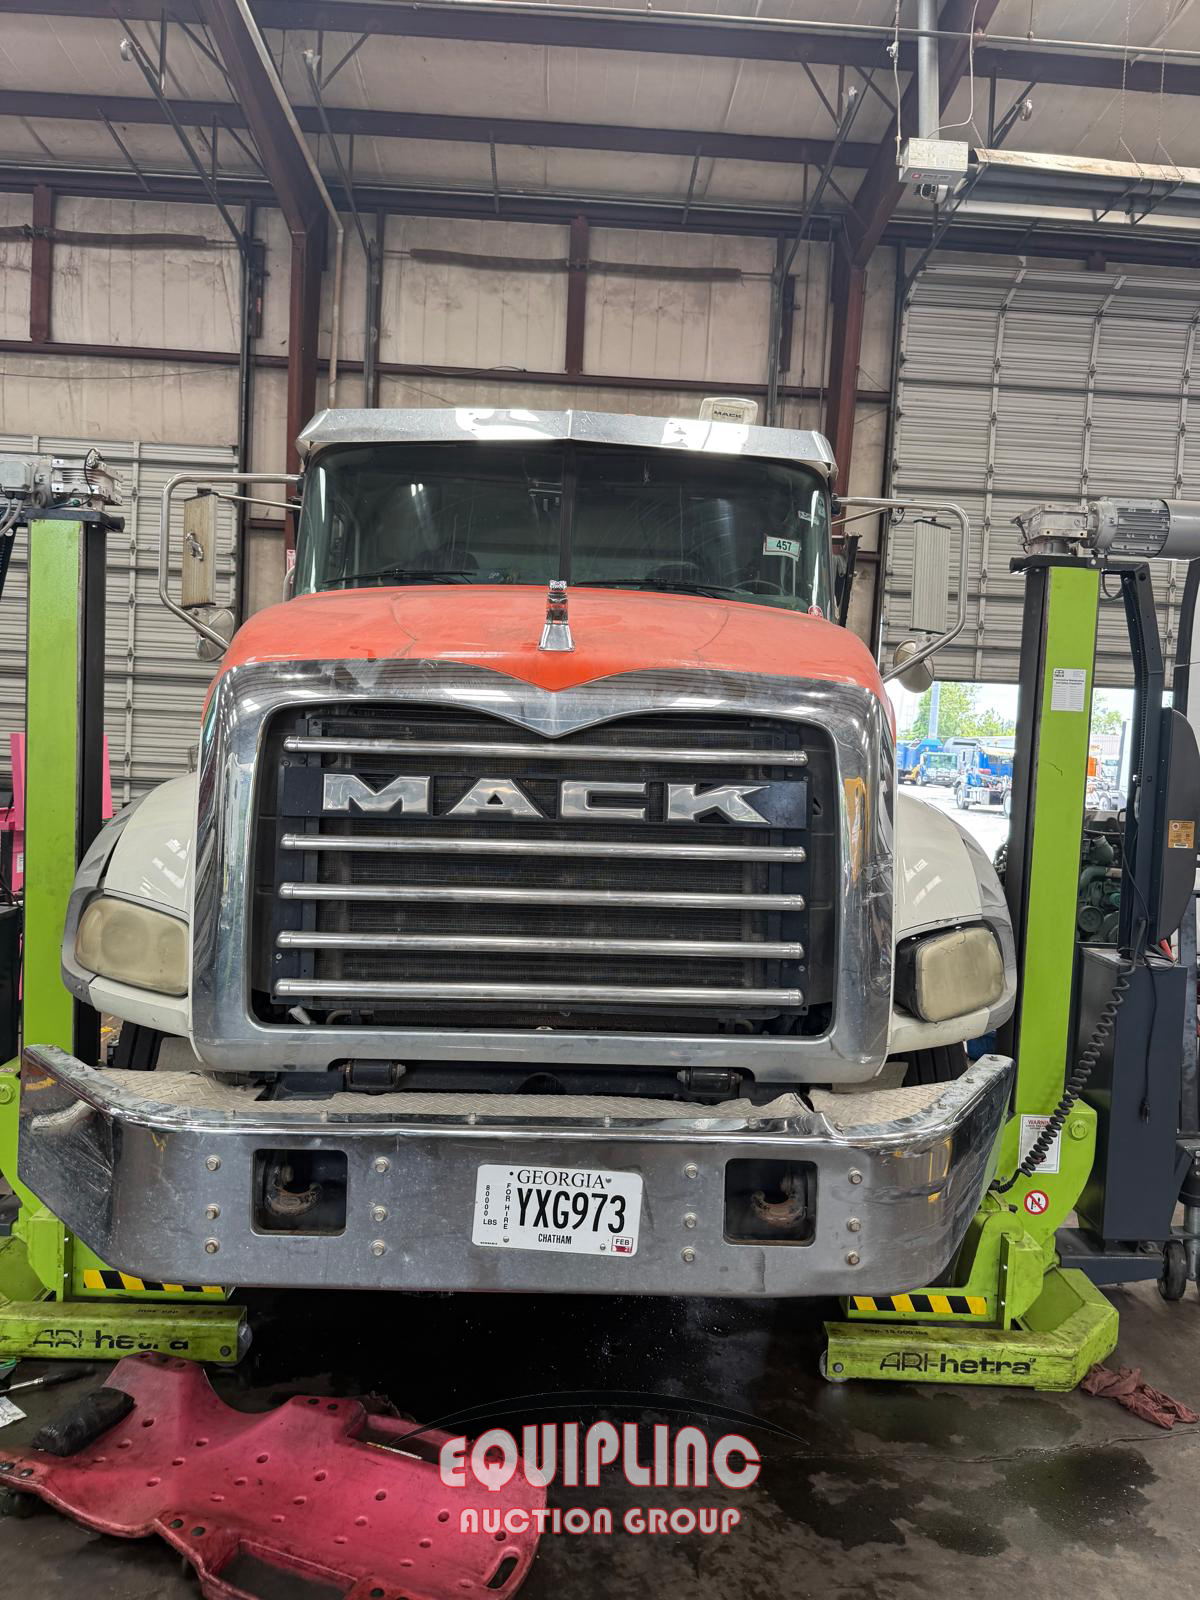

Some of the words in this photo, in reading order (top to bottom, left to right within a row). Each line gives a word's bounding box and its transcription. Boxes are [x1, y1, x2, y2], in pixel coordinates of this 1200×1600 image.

[776, 540, 792, 552] 457
[323, 773, 771, 824] MACK
[517, 1169, 606, 1189] GEORGIA
[517, 1187, 626, 1234] YXG973
[538, 1233, 572, 1245] CHATHAM
[615, 1238, 630, 1246] FEB
